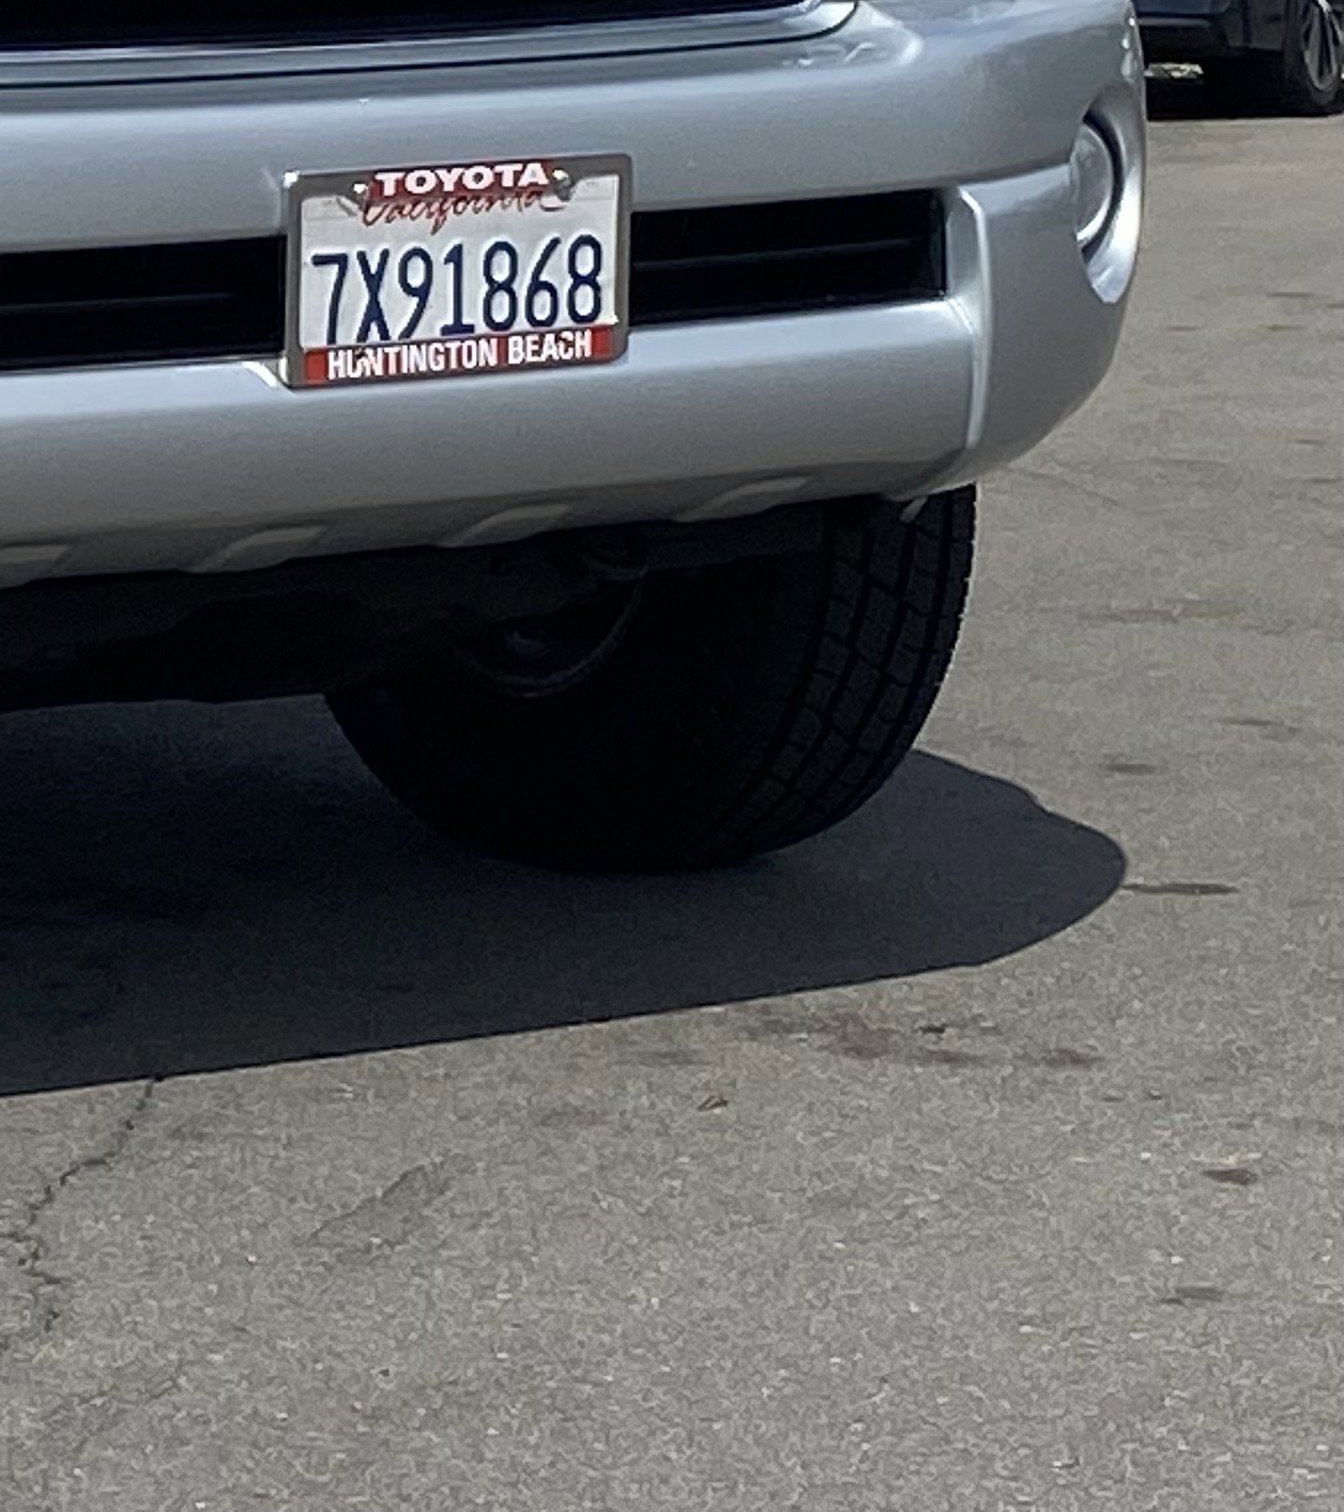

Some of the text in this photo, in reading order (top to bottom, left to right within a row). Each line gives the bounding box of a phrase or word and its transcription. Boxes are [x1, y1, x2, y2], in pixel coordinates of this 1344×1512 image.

[374, 162, 549, 197] TOYOTA
[312, 234, 603, 346] 7X91868
[327, 329, 593, 381] HUNTINGTON BEACH
